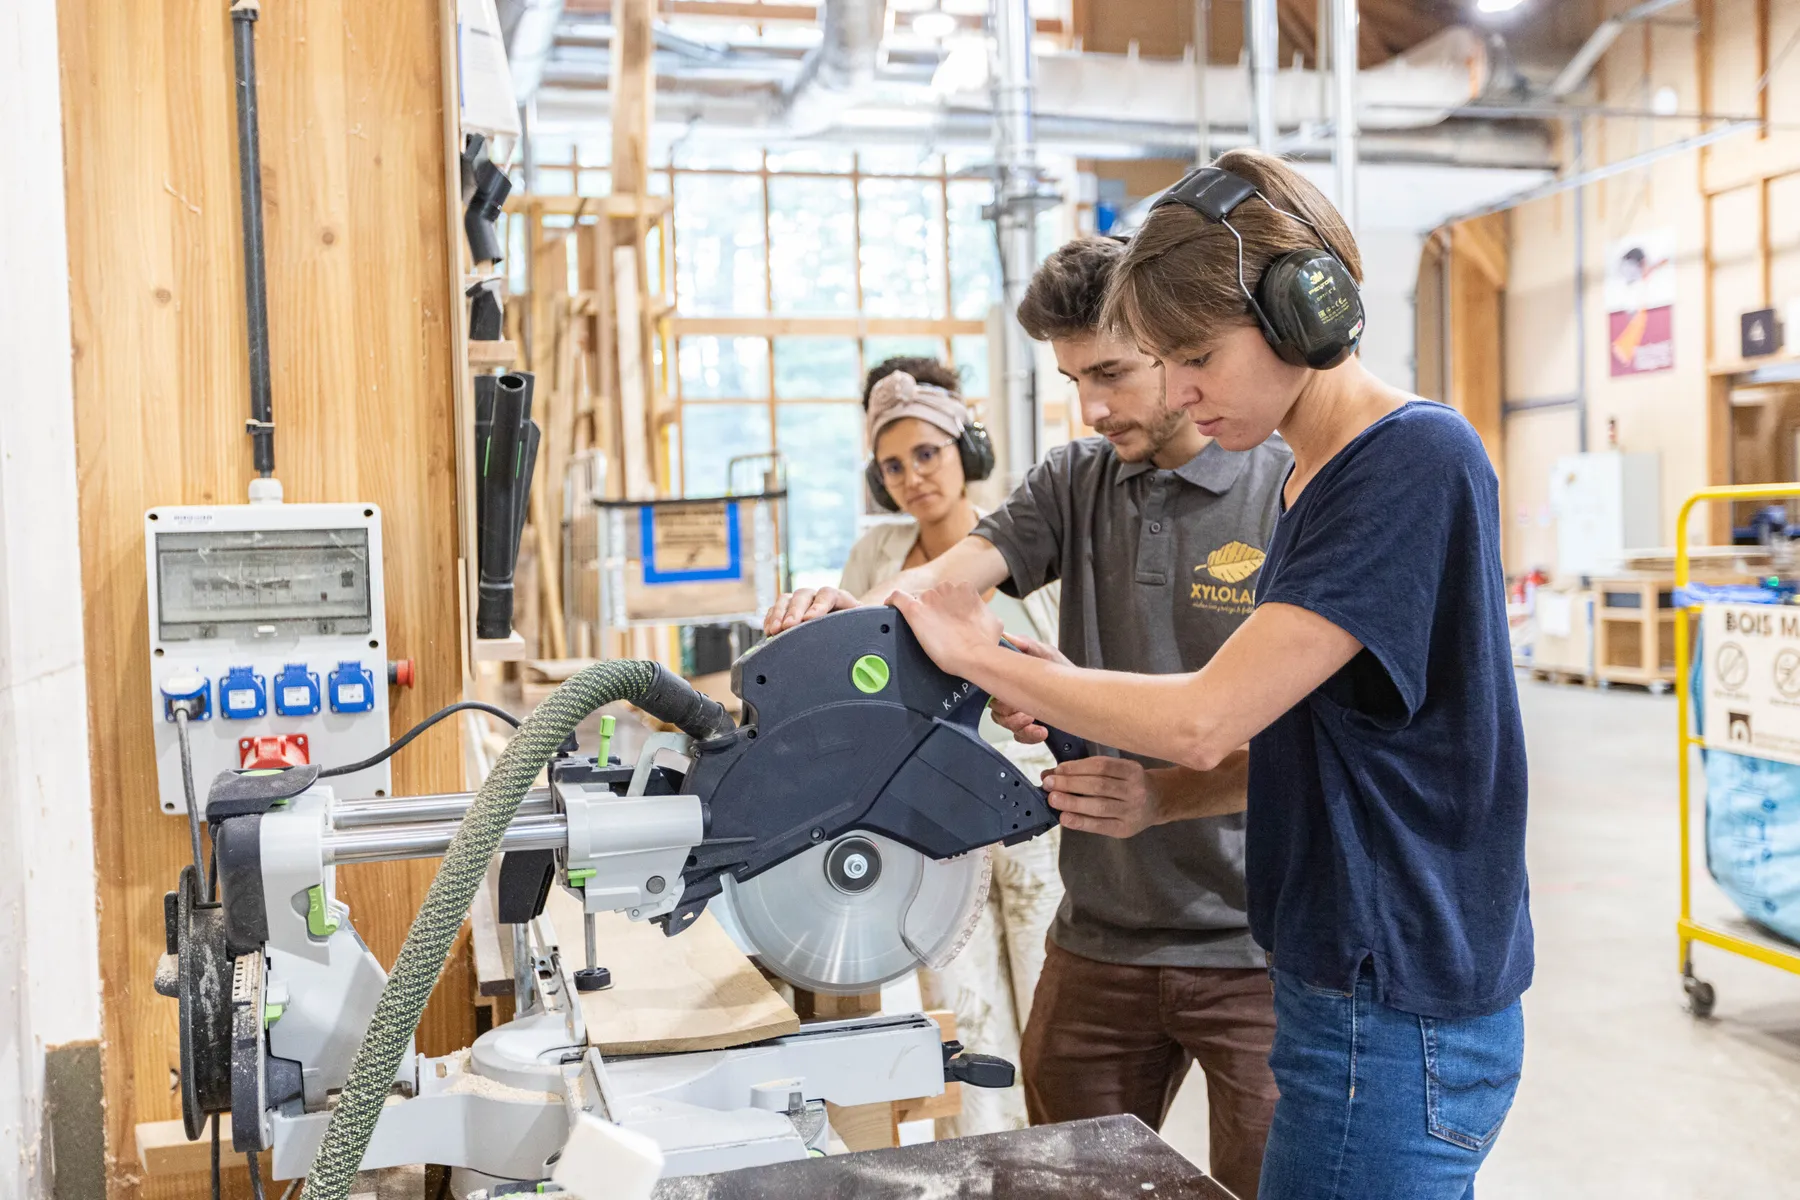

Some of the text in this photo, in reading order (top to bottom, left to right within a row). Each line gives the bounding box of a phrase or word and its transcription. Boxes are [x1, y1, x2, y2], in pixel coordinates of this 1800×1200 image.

[1310, 271, 1324, 285] 3M
[1726, 611, 1800, 638] BOIS M
